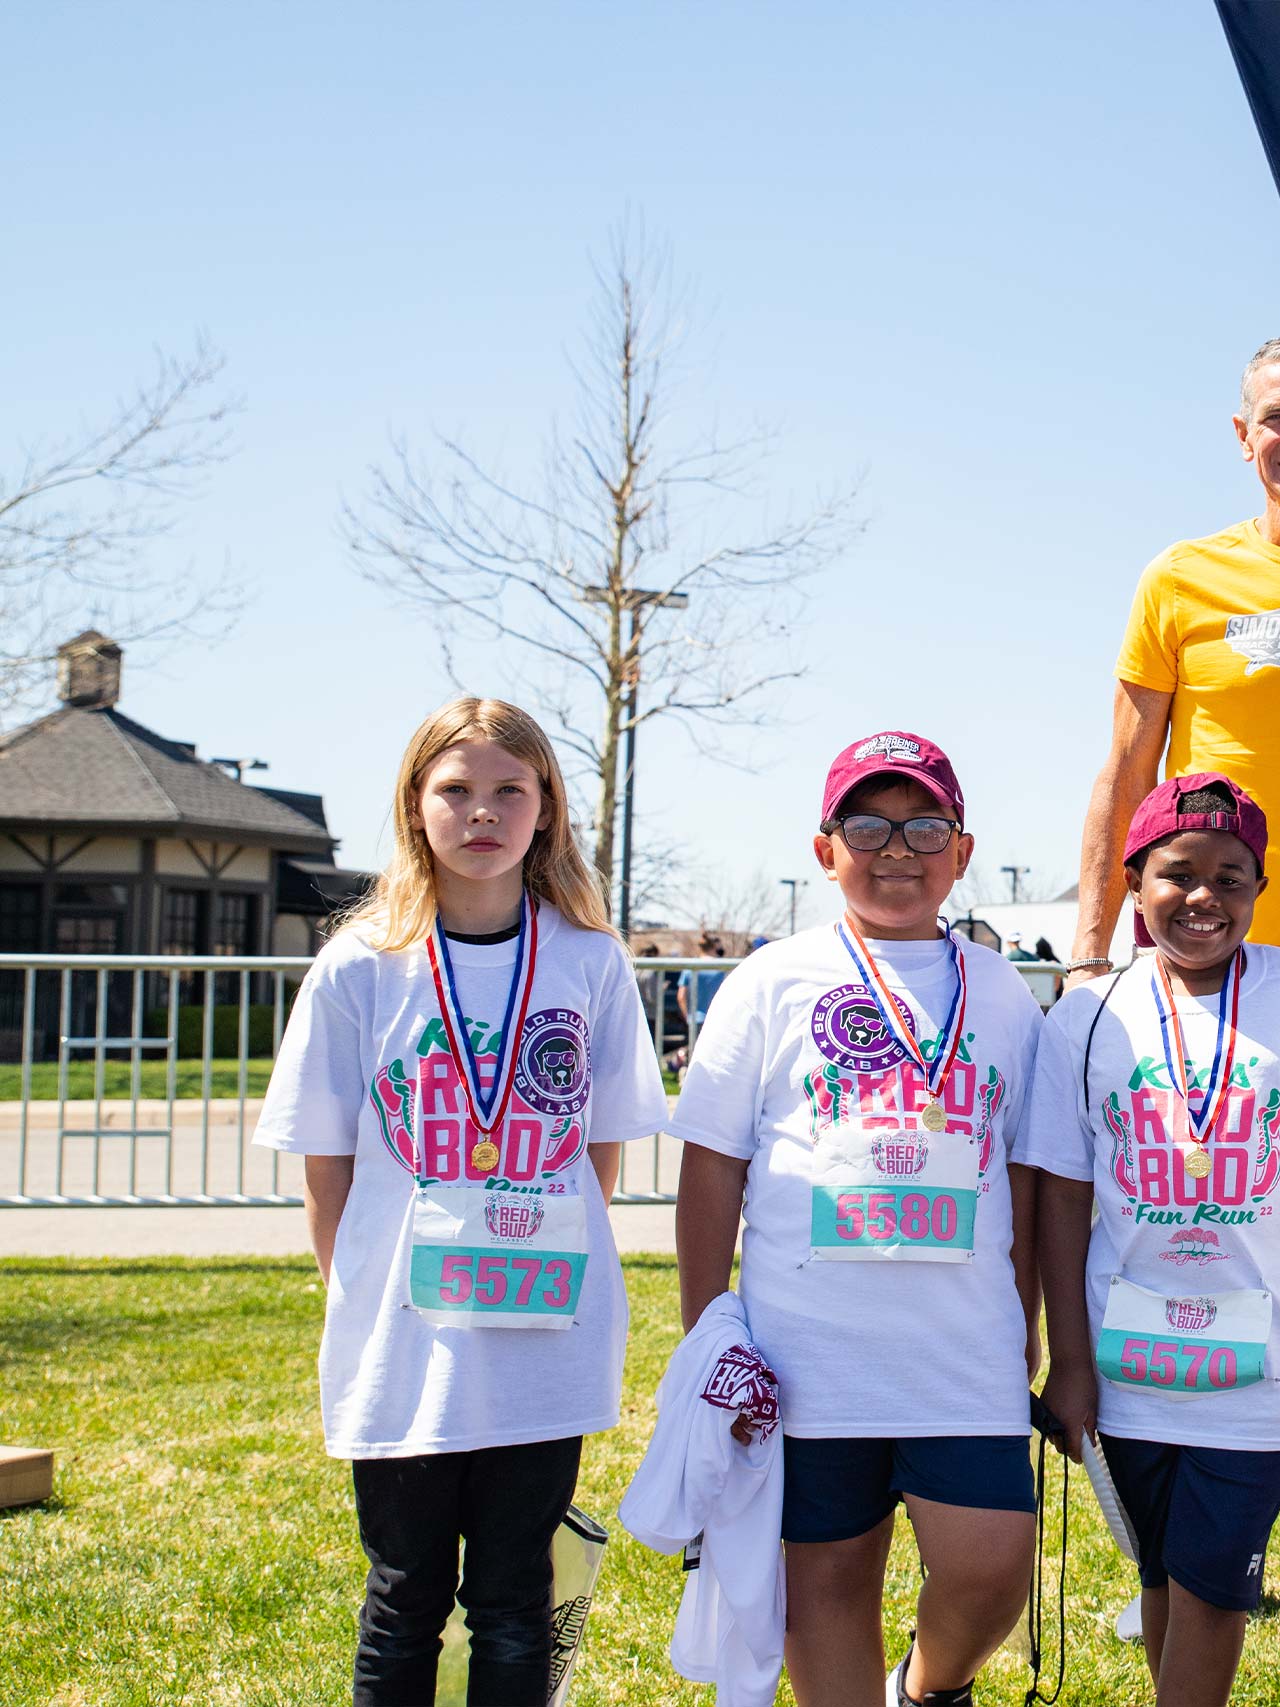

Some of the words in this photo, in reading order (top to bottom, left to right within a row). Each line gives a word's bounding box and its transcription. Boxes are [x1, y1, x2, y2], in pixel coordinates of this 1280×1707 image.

[814, 1012, 825, 1034] BE
[546, 1100, 581, 1114] LAB
[424, 1118, 543, 1181] BUD
[886, 1145, 915, 1159] RED
[886, 1160, 914, 1174] BUD
[1139, 1148, 1249, 1206] BUD
[548, 1184, 566, 1194] 22
[500, 1206, 530, 1223] RED
[836, 1193, 957, 1241] 5580
[1135, 1203, 1188, 1224] Fun
[1192, 1203, 1257, 1224] Run
[1260, 1207, 1272, 1216] 22
[500, 1222, 526, 1238] BUD
[440, 1255, 572, 1308] 5573
[1177, 1315, 1203, 1330] BUD
[1121, 1337, 1238, 1388] 5570
[554, 1601, 573, 1631] TRACK
[557, 1596, 592, 1647] SIMON
